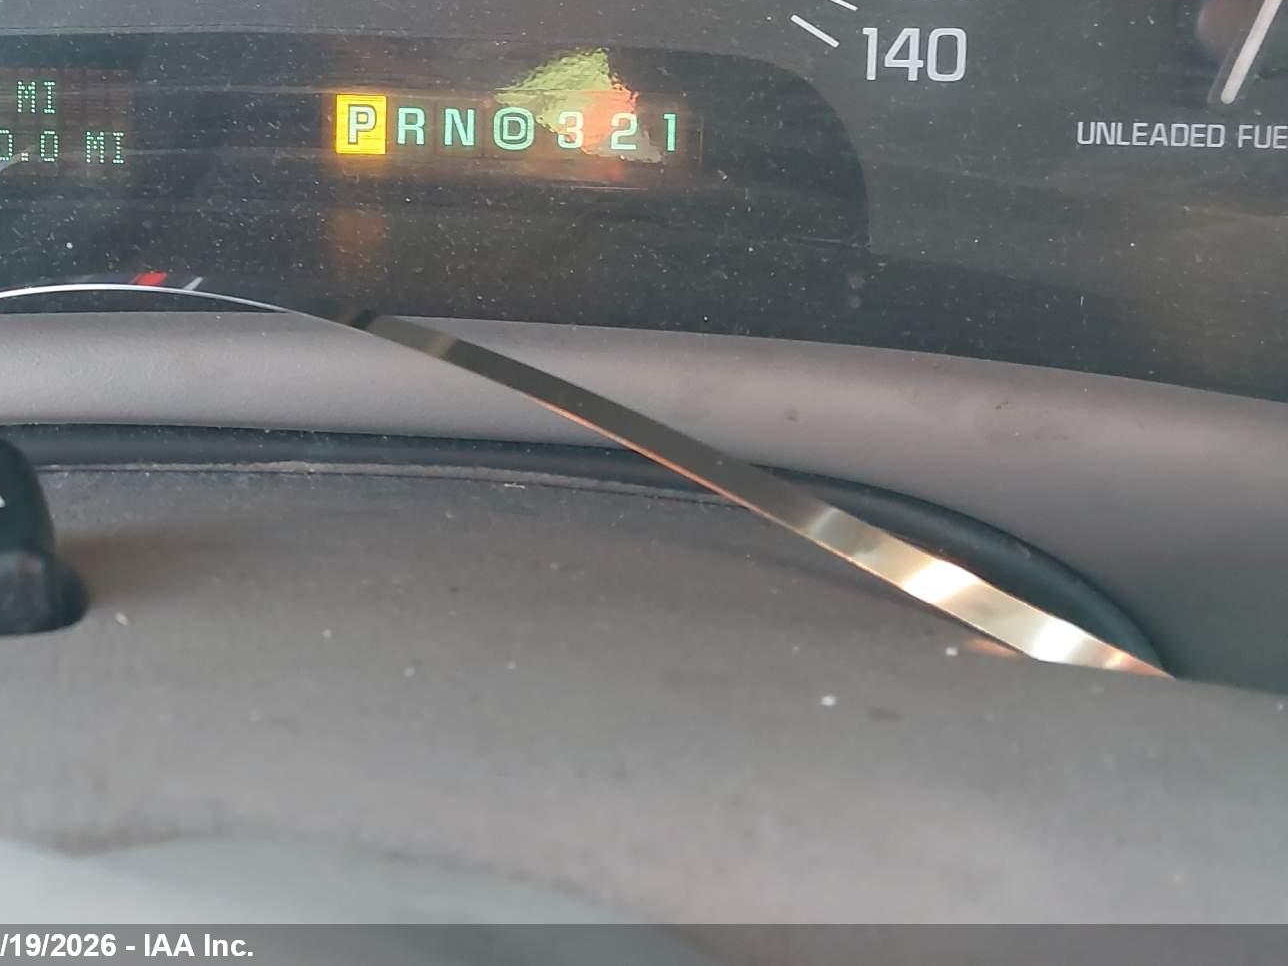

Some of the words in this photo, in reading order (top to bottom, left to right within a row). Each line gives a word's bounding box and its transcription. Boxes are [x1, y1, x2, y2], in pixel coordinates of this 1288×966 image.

[862, 27, 969, 83] 140
[16, 80, 58, 116] MI
[347, 104, 378, 146] P
[396, 106, 426, 146] R
[443, 107, 476, 147] N
[557, 110, 584, 149] 3
[610, 112, 639, 151] 2
[662, 112, 679, 152] 1
[1076, 121, 1226, 149] UNLEADED
[85, 130, 127, 165] MI
